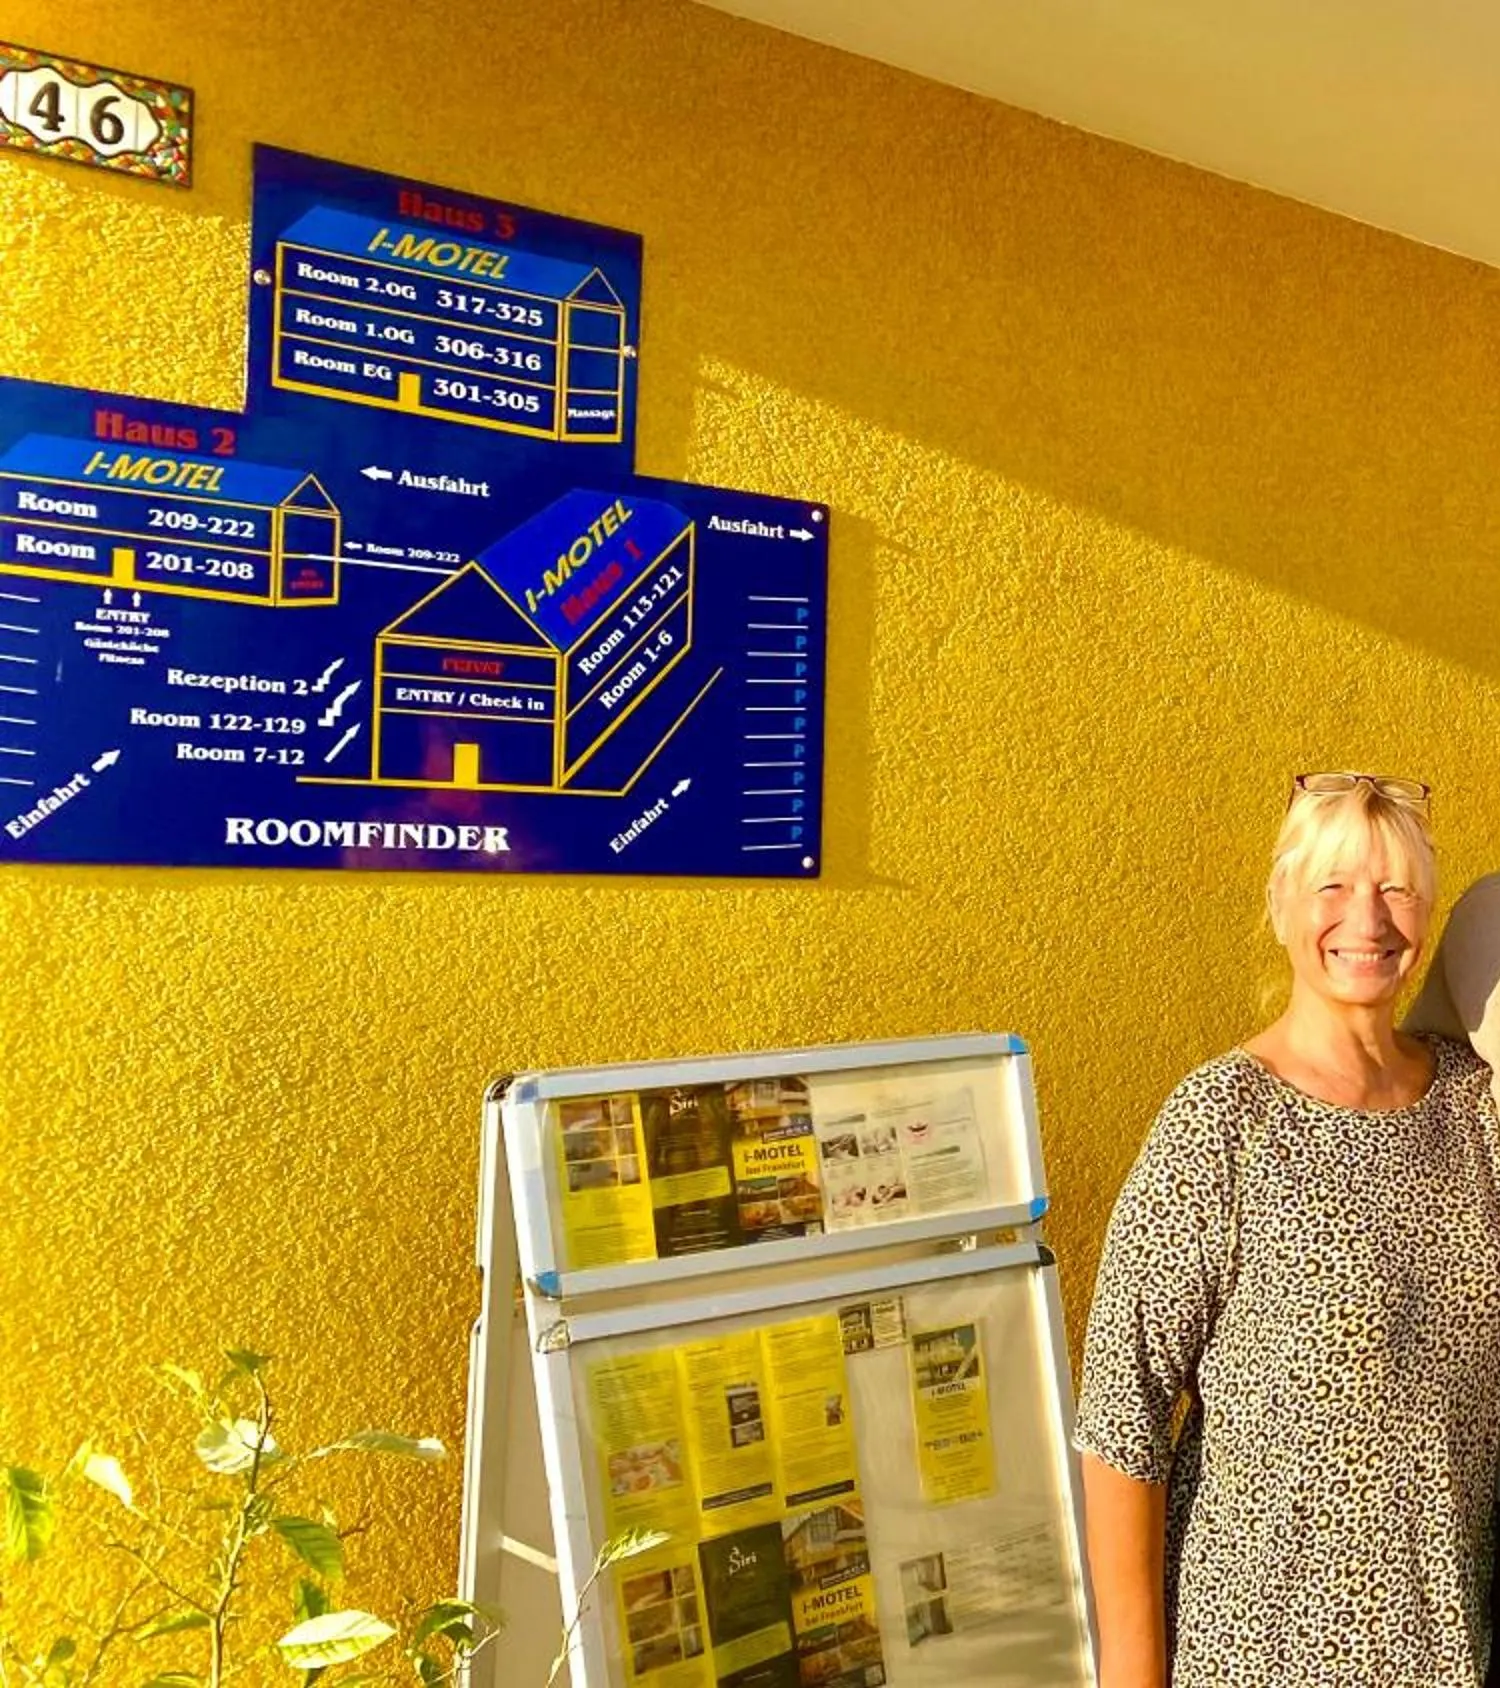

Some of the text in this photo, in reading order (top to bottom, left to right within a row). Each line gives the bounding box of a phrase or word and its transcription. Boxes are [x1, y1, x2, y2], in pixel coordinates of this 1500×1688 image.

[28, 80, 125, 147] 46
[399, 191, 516, 240] Haus 3
[367, 228, 509, 279] I-MOTEL
[297, 262, 359, 290] Room
[436, 289, 544, 327] 317-325
[295, 308, 357, 335] Room
[434, 335, 543, 372] 306-316
[293, 350, 541, 413] Room EG 301-305
[94, 409, 236, 456] Haus 2
[83, 451, 226, 492] I-MOTEL
[397, 469, 491, 498] Ausfahrt
[17, 491, 256, 539] Room 209-222
[708, 515, 785, 540] Ausfahrt
[15, 533, 255, 581] Room 201-208
[407, 547, 461, 563] 209-222
[524, 498, 634, 614] I-MOTEL
[95, 607, 151, 624] ENTRY
[577, 565, 685, 677] Room 113-121
[796, 607, 808, 622] P
[796, 636, 807, 651] P
[166, 668, 309, 694] Rezeption 2
[598, 629, 674, 710] Room 1-6
[795, 661, 807, 676] P
[395, 686, 455, 704] ENTRY
[468, 692, 524, 709] Check
[527, 697, 546, 711] in
[795, 689, 806, 704] P
[130, 707, 306, 735] Room 122-129
[794, 717, 806, 733] P
[176, 743, 305, 766] Room 7-12
[793, 744, 805, 759] P
[793, 772, 804, 786] P
[4, 774, 92, 840] Einfahrt
[791, 798, 804, 813] P
[224, 817, 511, 852] ROOMFINDER
[608, 797, 670, 856] Einfahrt
[791, 826, 803, 841] P
